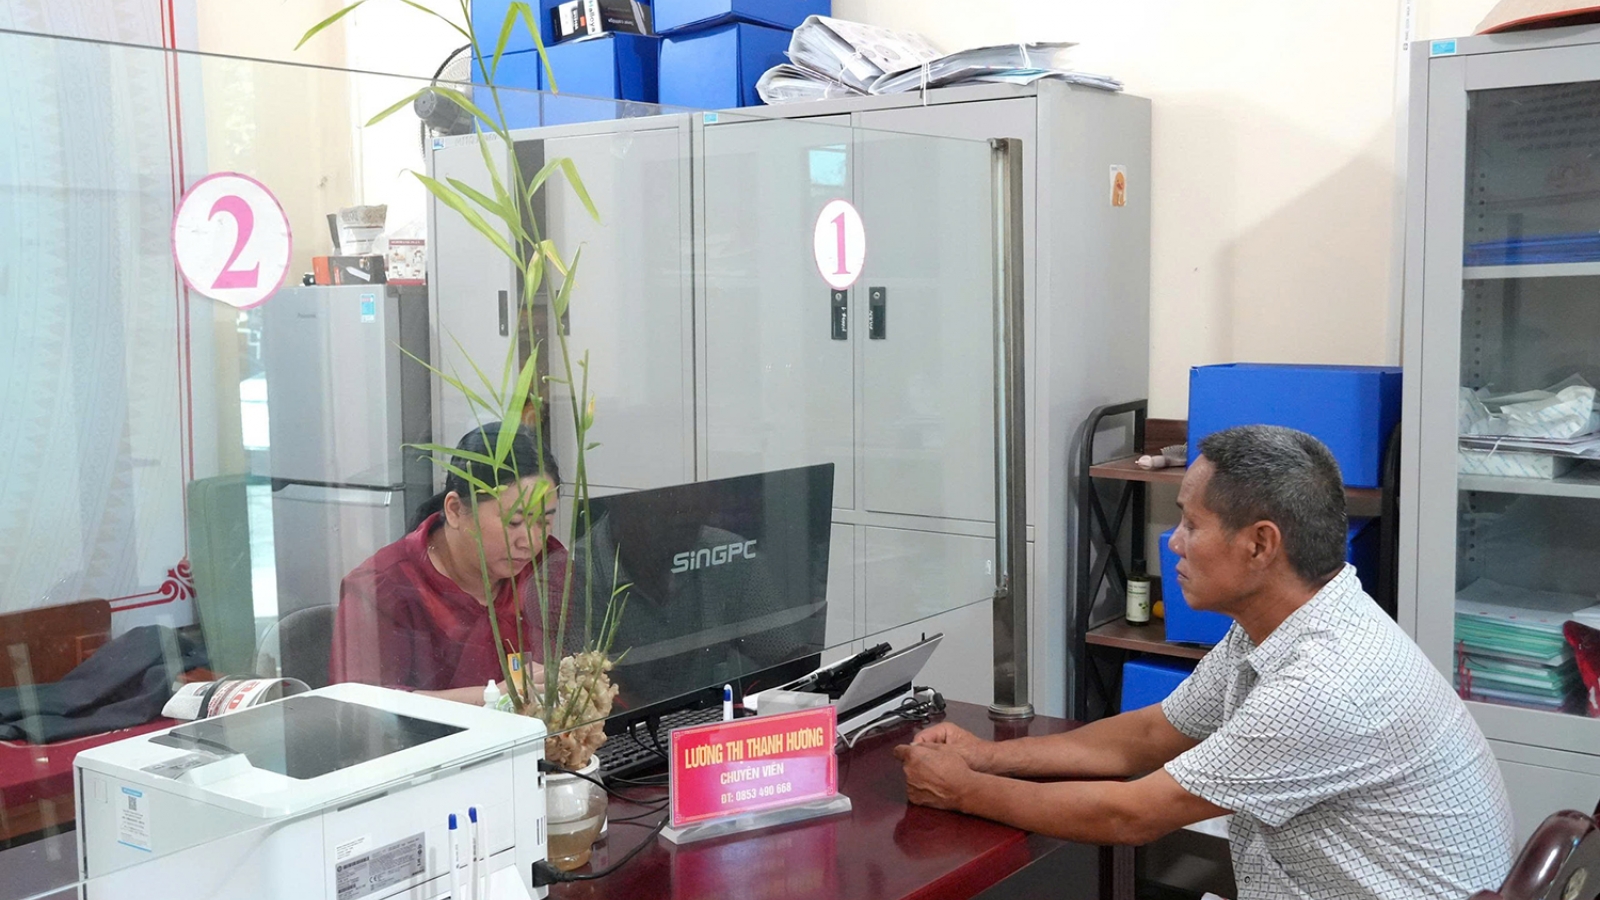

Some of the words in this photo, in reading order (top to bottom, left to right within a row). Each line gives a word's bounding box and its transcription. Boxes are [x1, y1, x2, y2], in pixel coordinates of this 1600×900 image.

[208, 195, 260, 289] 2
[830, 211, 851, 275] 1
[685, 744, 723, 769] LƯƠNG
[725, 740, 744, 764] THỊ
[747, 734, 784, 758] THANH
[786, 727, 824, 751] HƯƠNG
[720, 766, 760, 785] CHUYÊN
[762, 763, 785, 778] VIÊN
[721, 794, 734, 804] ĐT:
[736, 789, 757, 801] 0853
[759, 786, 774, 797] 490
[776, 782, 792, 793] 668
